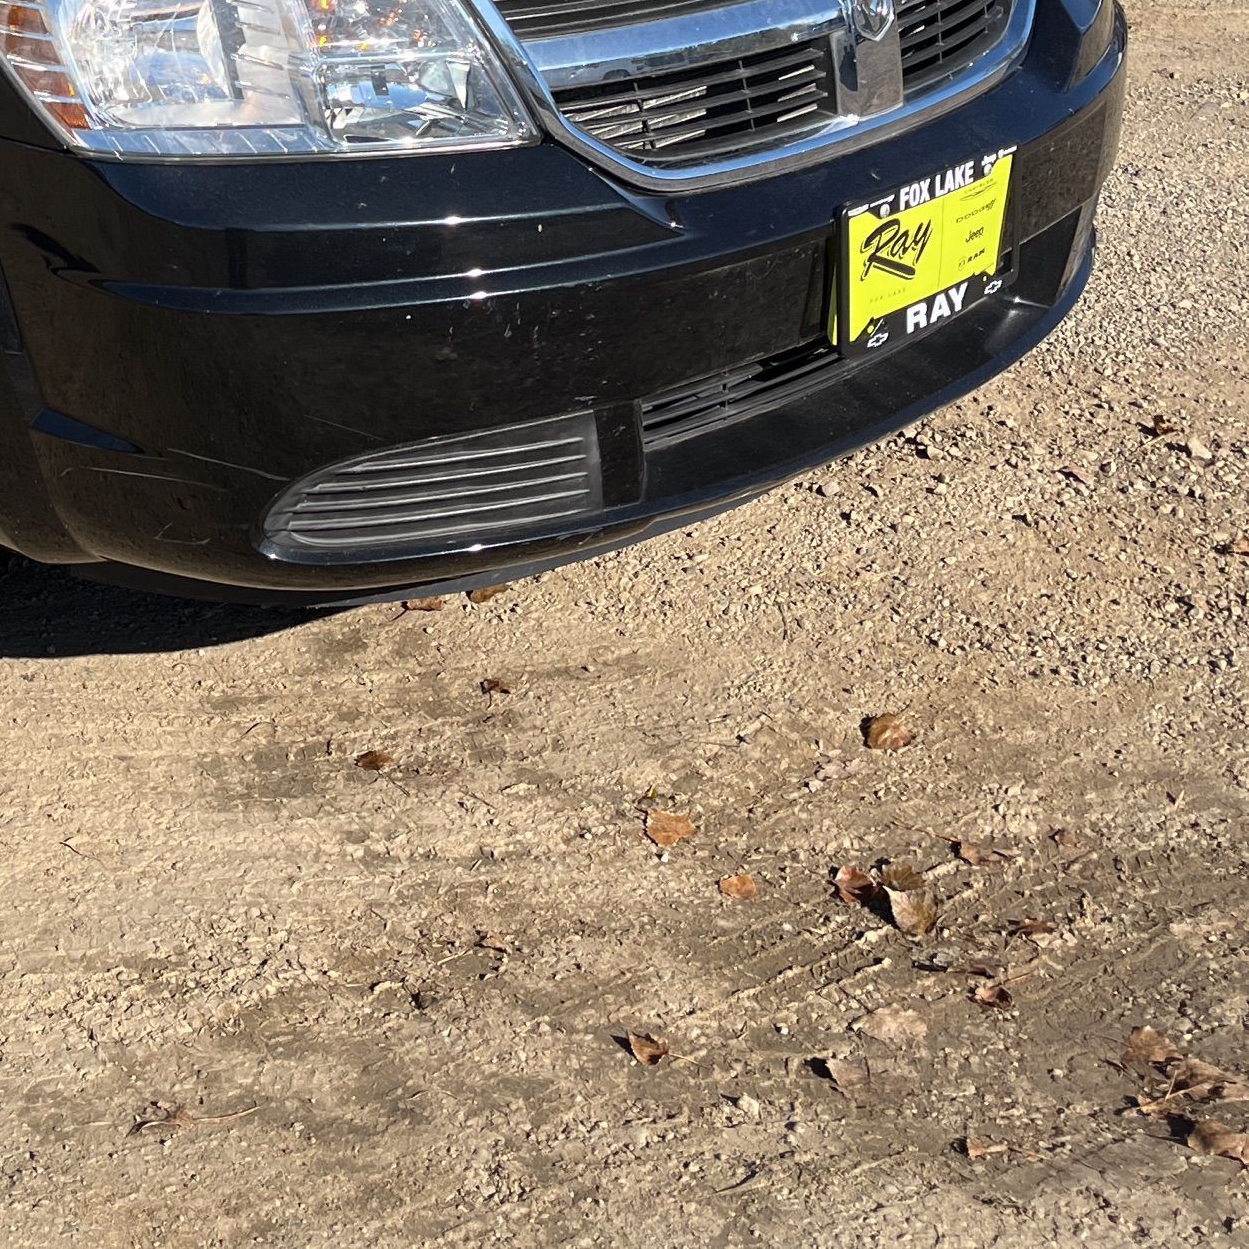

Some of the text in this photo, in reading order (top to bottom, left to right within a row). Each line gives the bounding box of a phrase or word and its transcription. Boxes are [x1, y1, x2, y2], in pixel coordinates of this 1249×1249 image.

[899, 178, 931, 211] FOX
[935, 160, 975, 193] LAKE
[860, 218, 932, 282] Ray
[965, 226, 985, 244] Jeep
[967, 248, 986, 263] RAM
[906, 282, 968, 334] RAY
